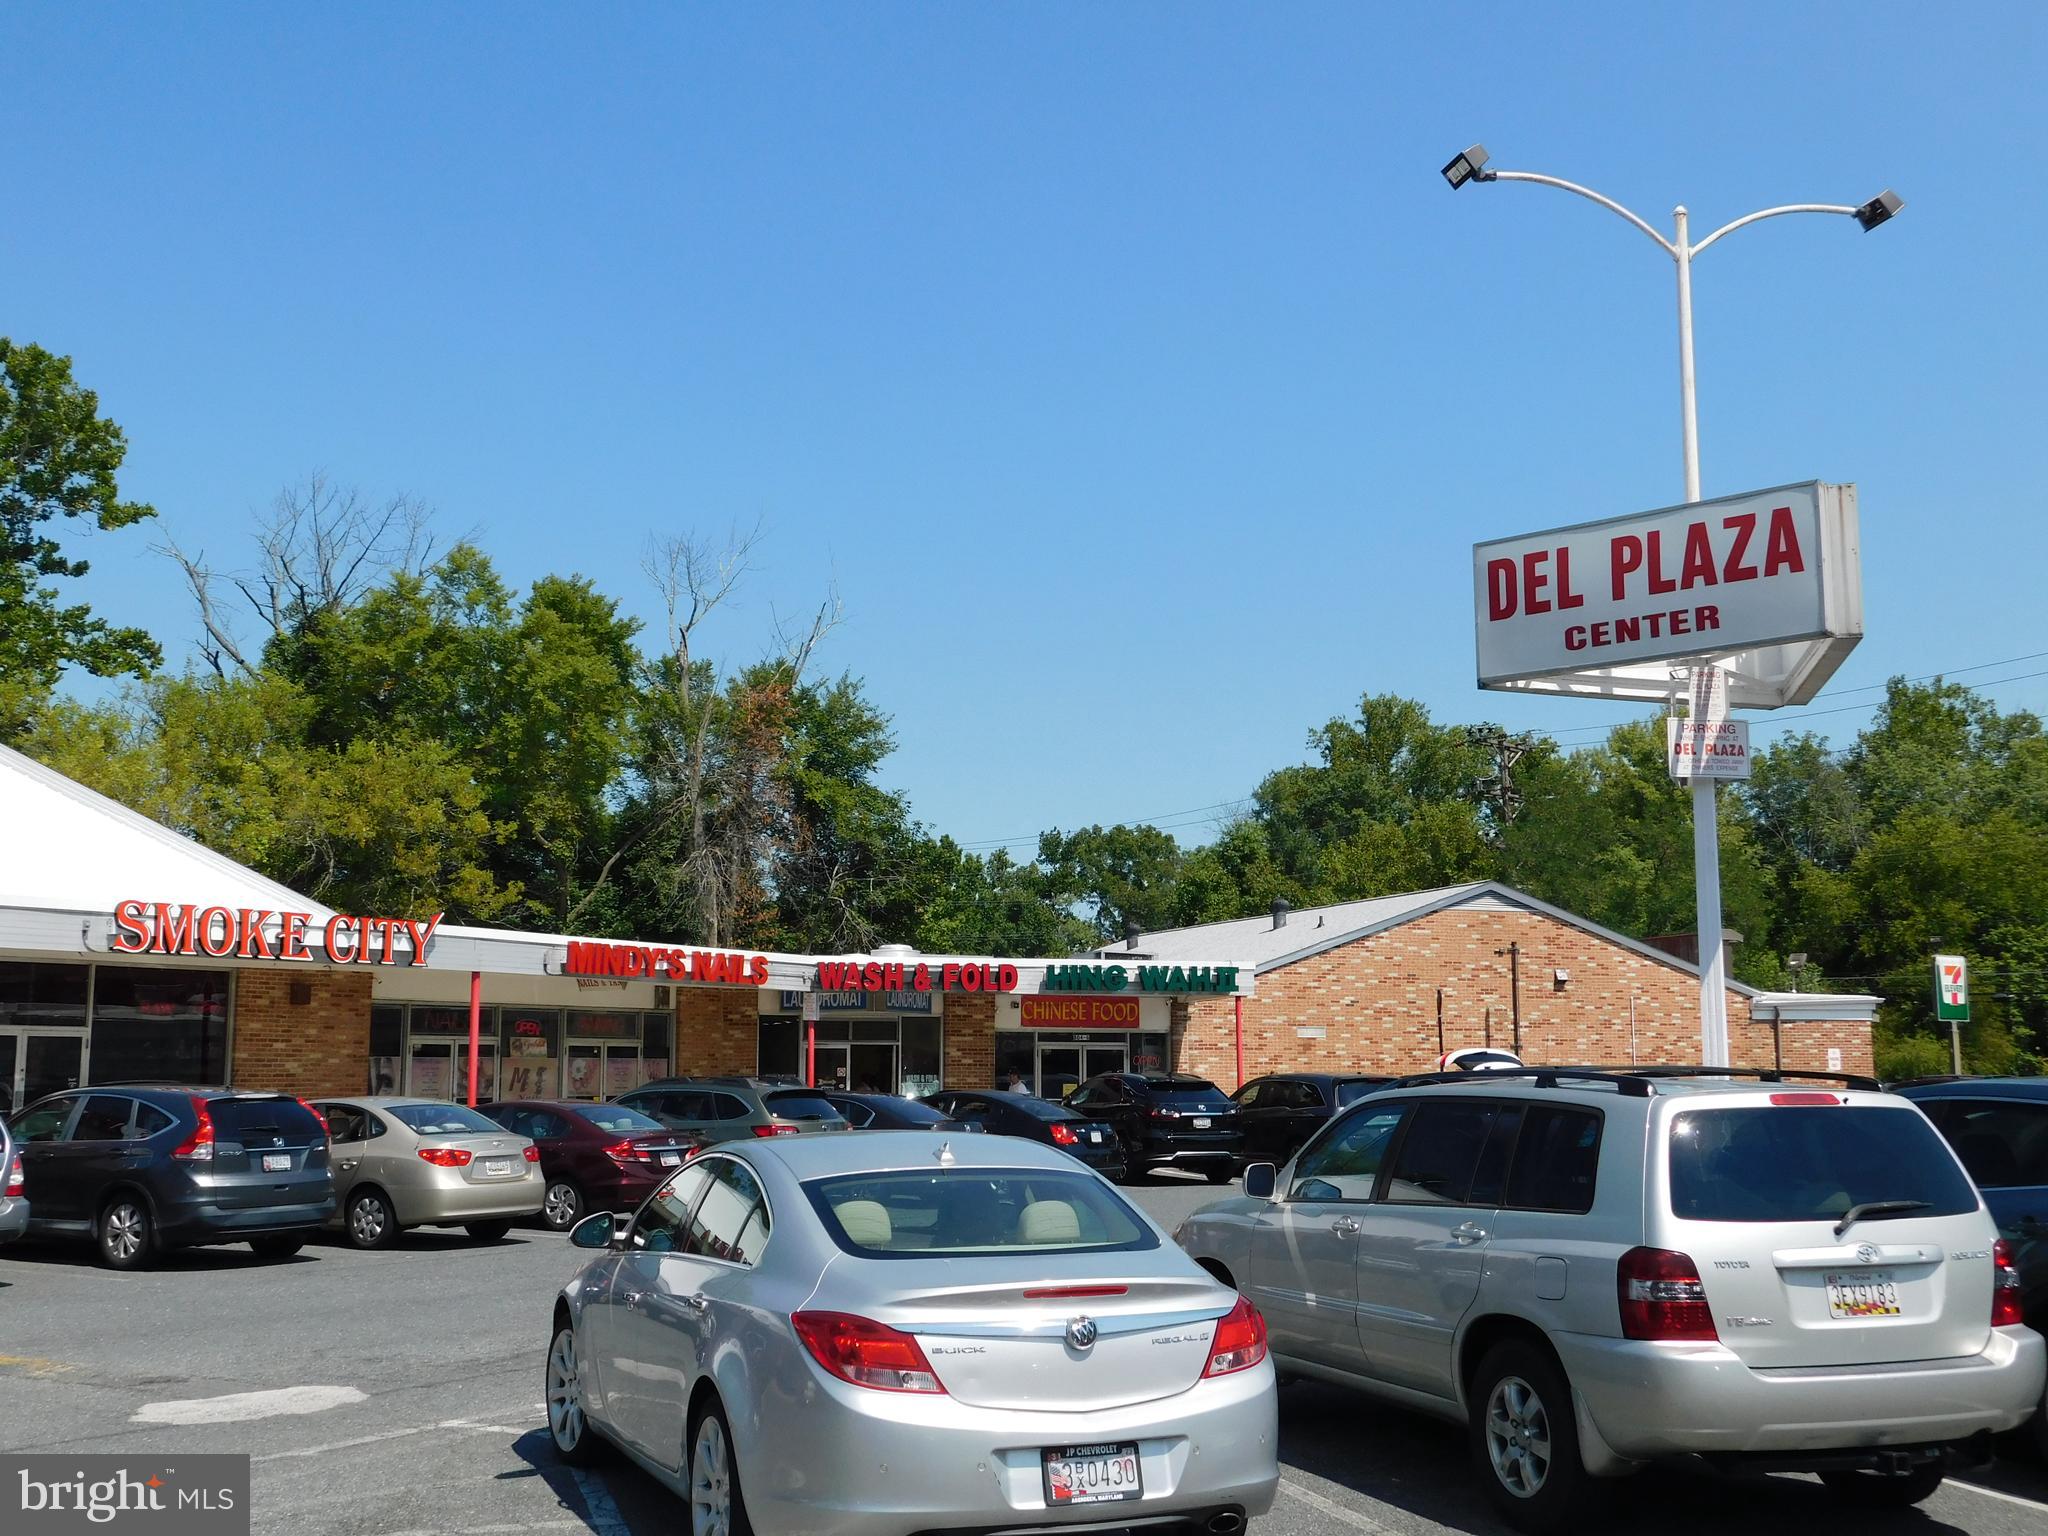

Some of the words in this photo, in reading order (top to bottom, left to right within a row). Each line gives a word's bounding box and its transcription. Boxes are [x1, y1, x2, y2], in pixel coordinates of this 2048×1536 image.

[1487, 546, 1584, 621] DEL
[1610, 507, 1805, 601] PLAZA
[1564, 605, 1720, 651] CENTER
[1682, 723, 1736, 734] PARKING
[1674, 743, 1697, 756] DEL
[1705, 744, 1745, 757] PLAZA
[112, 899, 314, 962] SMOKE
[325, 911, 445, 967] CITY
[566, 940, 687, 981] MINDY'S
[691, 951, 769, 985] NAILS
[817, 961, 904, 992] WASH
[914, 962, 932, 992] &
[943, 962, 1019, 992] FOLD
[1046, 964, 1129, 992] HING
[1138, 965, 1210, 992] WAH
[1021, 1001, 1087, 1021] CHINESE
[1092, 1002, 1138, 1022] FOOD
[1713, 1261, 1750, 1270] TOYOTA
[931, 1345, 986, 1355] BUICK
[1066, 1447, 1076, 1457] JP
[1076, 1444, 1118, 1457] CHEVROLET
